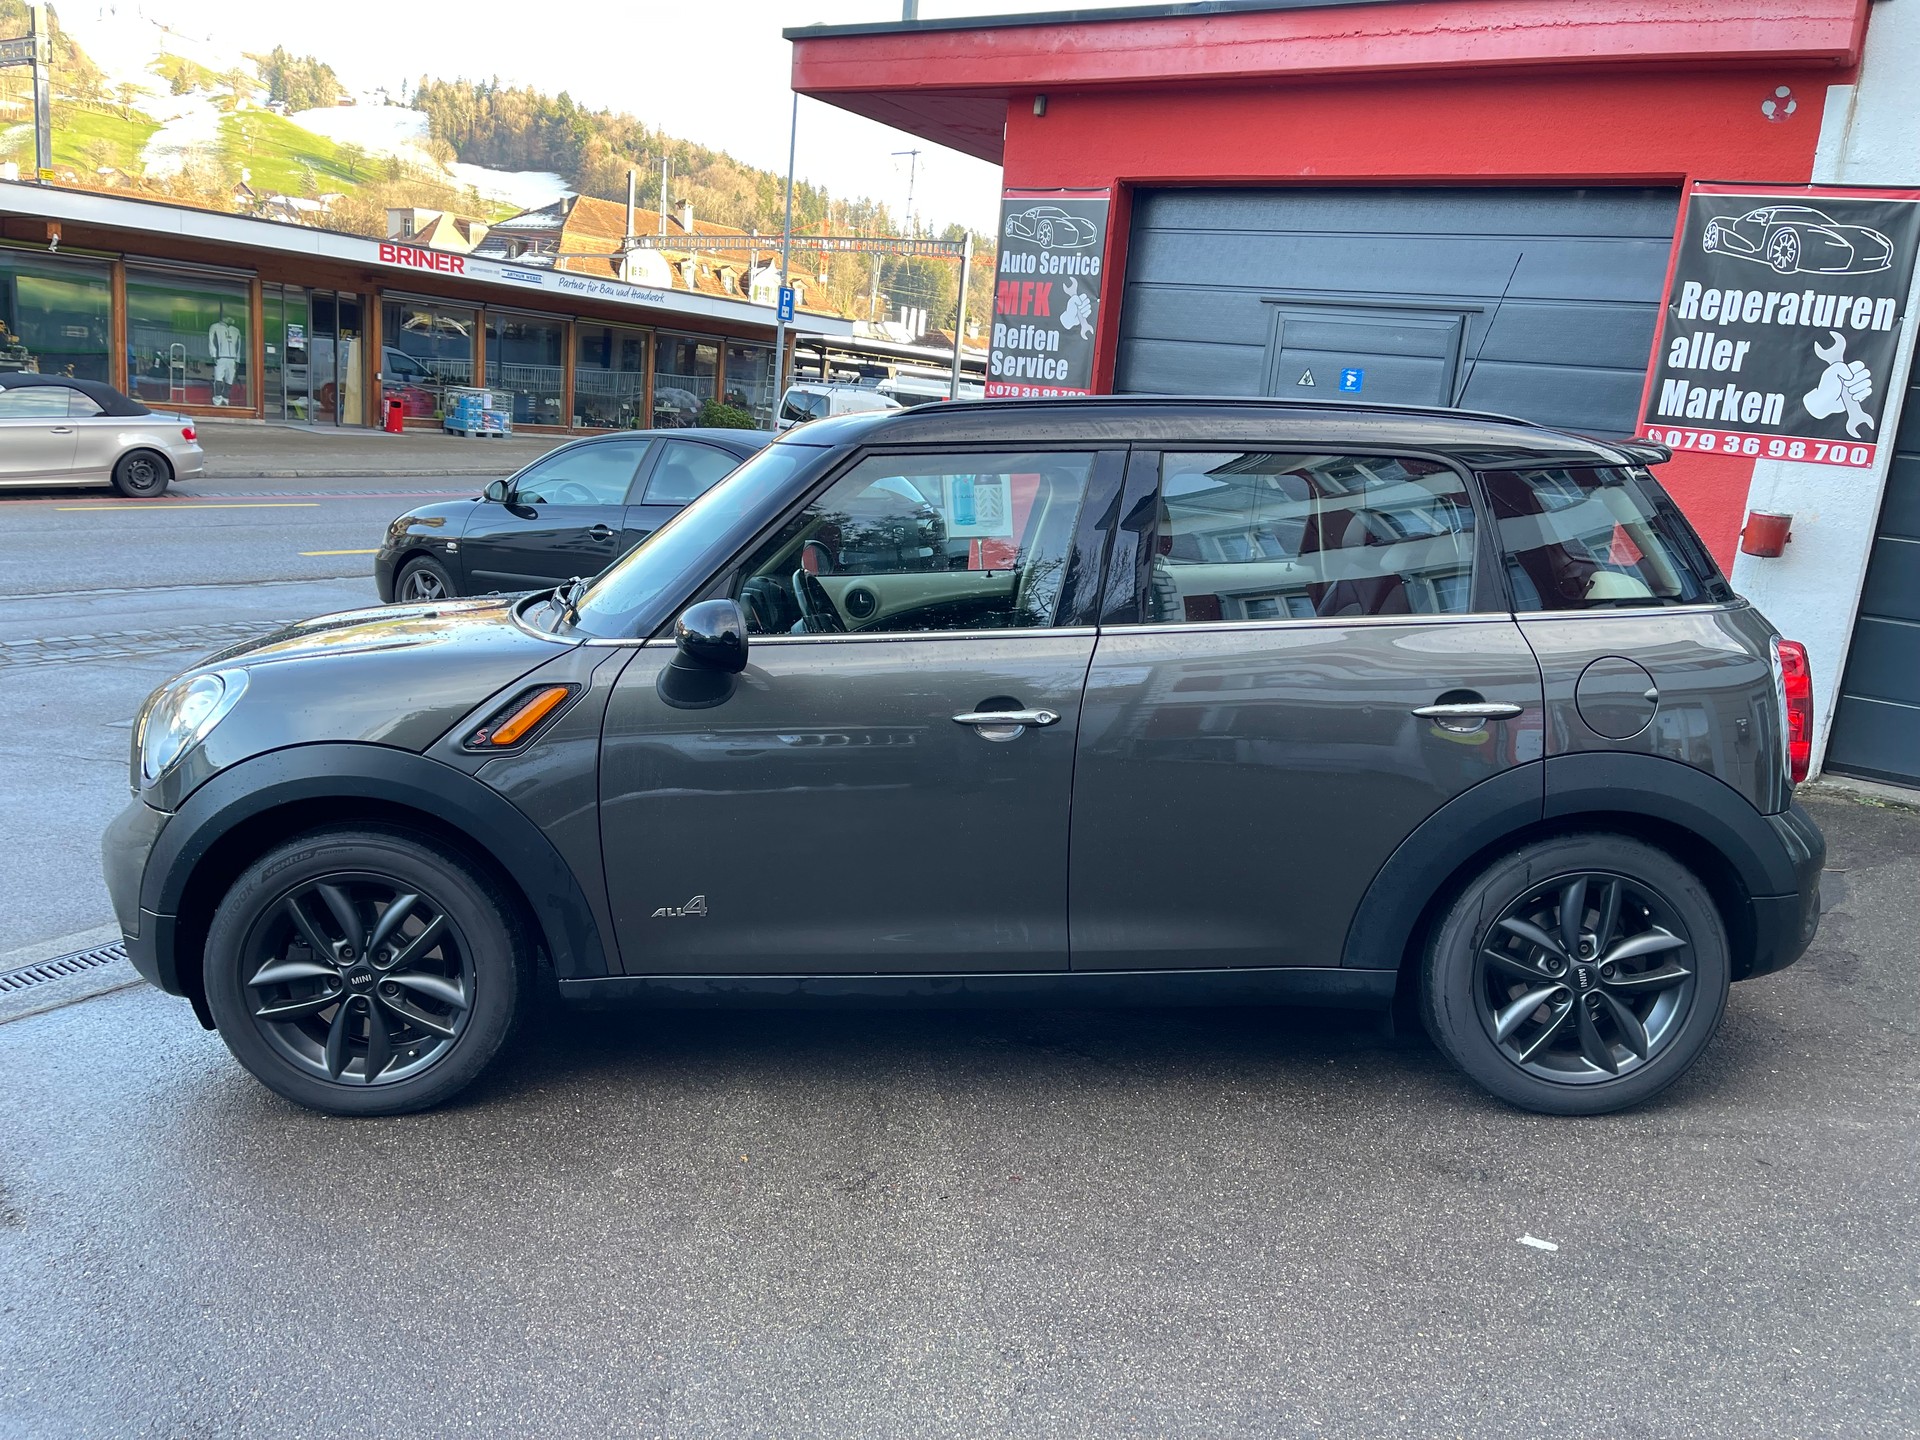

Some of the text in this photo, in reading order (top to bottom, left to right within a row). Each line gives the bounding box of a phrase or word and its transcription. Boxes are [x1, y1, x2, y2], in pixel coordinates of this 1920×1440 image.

[378, 243, 465, 275] BRINER
[1000, 250, 1100, 276] Auto Service
[507, 271, 525, 279] ARTHUR
[558, 276, 665, 303] Partner für Bau und Handwerk
[783, 290, 791, 306] P
[996, 280, 1053, 317] MFK
[1678, 280, 1896, 332] Reperaturen
[993, 322, 1060, 352] Reifen
[990, 351, 1069, 381] Service
[1667, 331, 1751, 373] aller
[996, 384, 1019, 397] 079
[1022, 387, 1040, 397] 36
[1657, 378, 1785, 426] Marken
[1665, 430, 1869, 465] 079 36 98 700
[651, 894, 708, 918] ALL4
[351, 974, 372, 985] MINI
[1578, 968, 1588, 988] MINI
